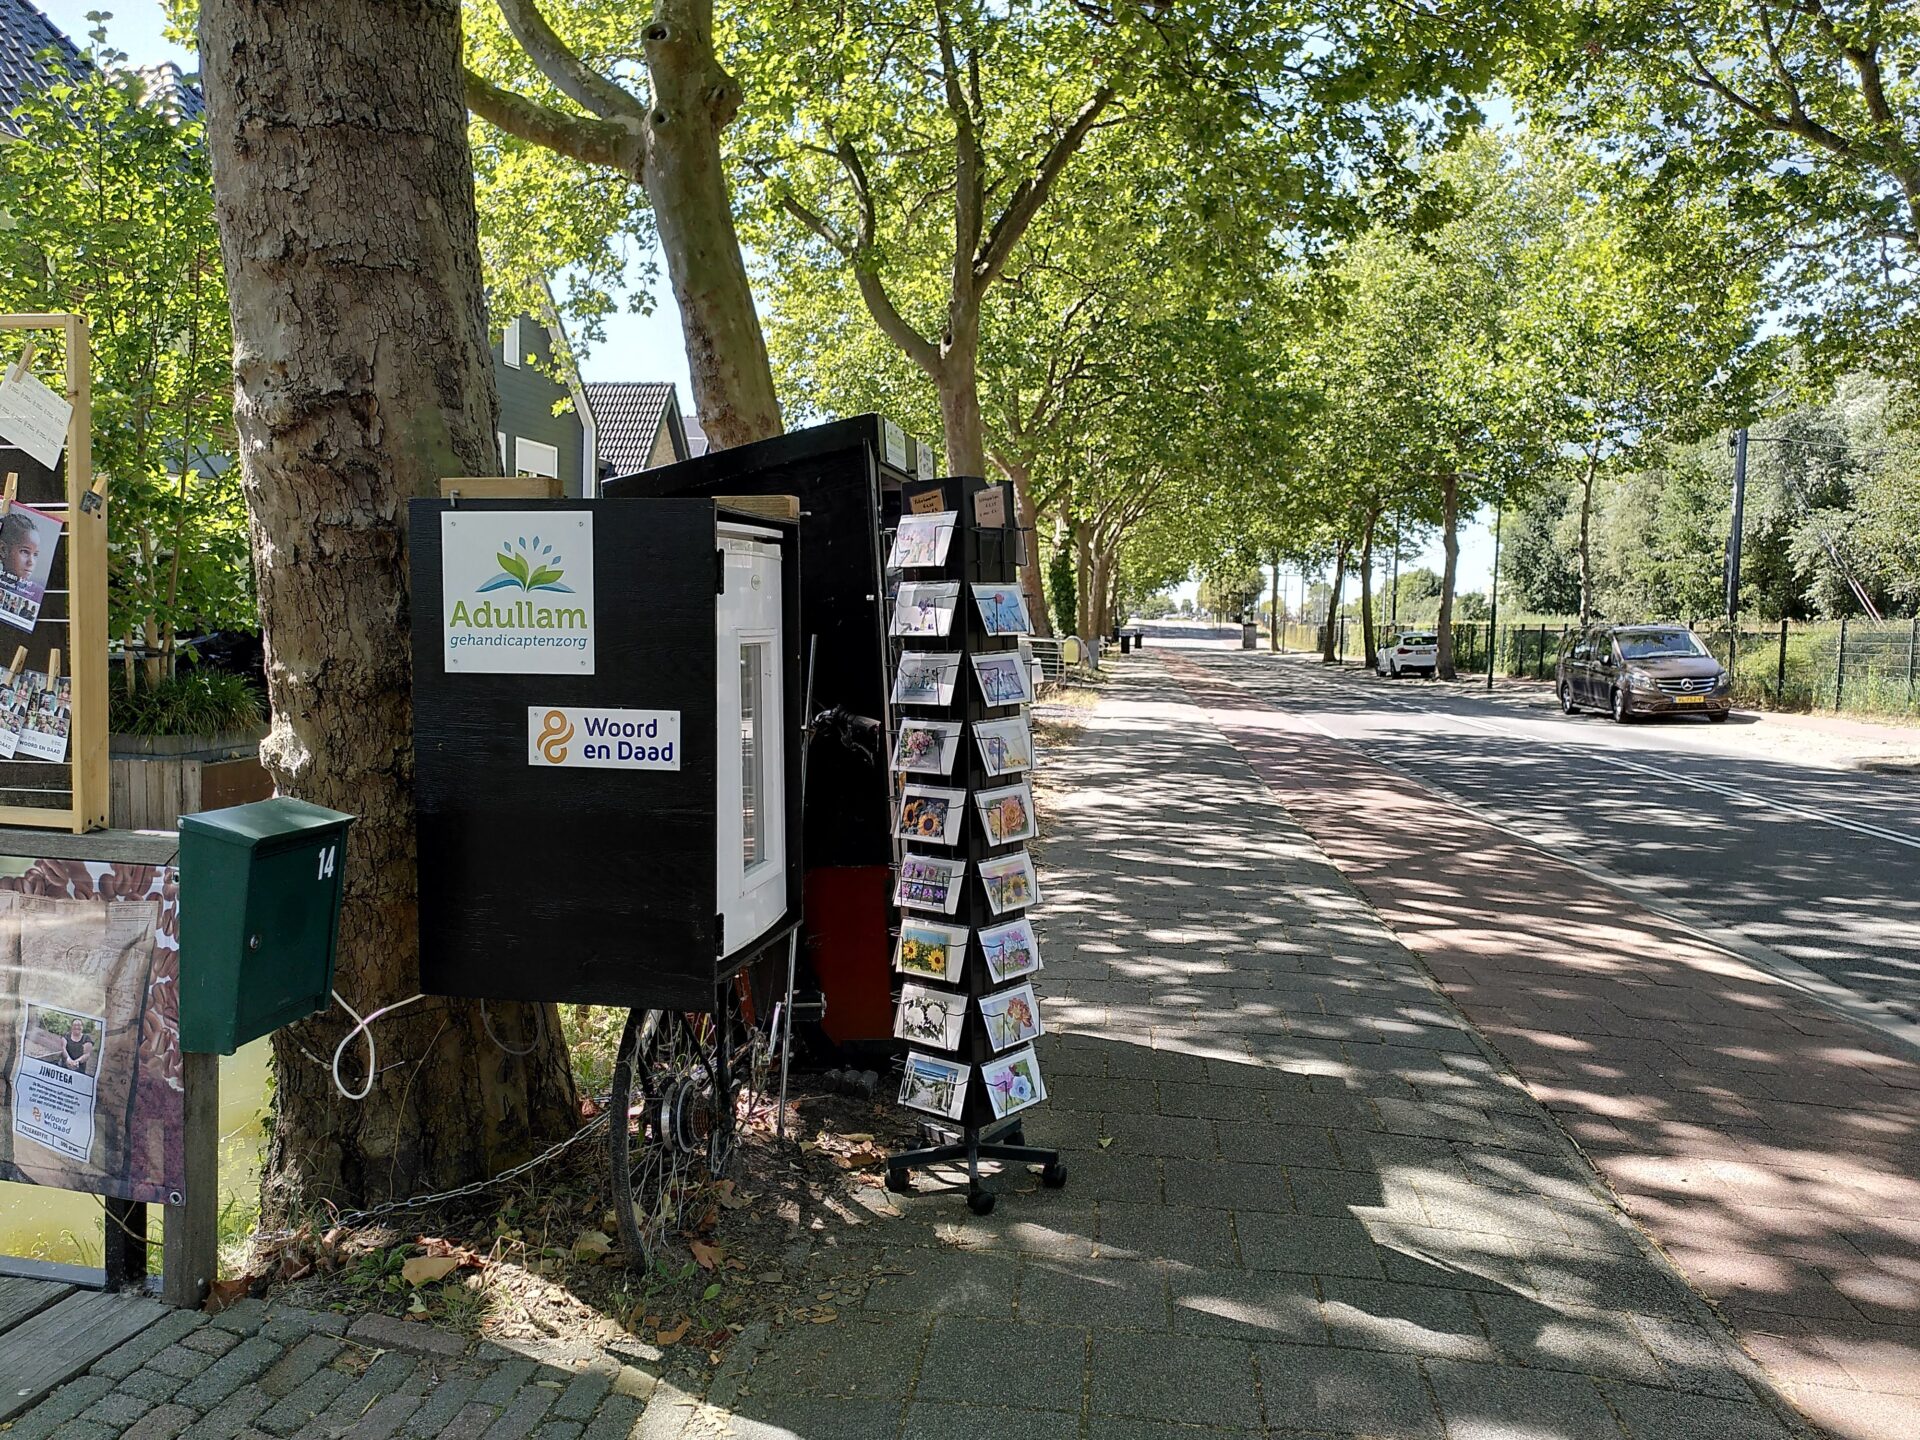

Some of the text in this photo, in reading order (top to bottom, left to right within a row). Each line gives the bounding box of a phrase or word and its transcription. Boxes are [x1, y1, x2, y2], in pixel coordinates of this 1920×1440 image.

[450, 600, 587, 629] Adullam
[450, 634, 587, 650] gehandicaptenzorg
[584, 717, 658, 738] Woord
[19, 740, 38, 749] WOORD
[47, 747, 61, 755] DAAD
[583, 741, 674, 762] en Daad
[317, 845, 336, 881] 14
[38, 1065, 73, 1086] JINOTEGA
[44, 1111, 69, 1125] Woord
[52, 1122, 72, 1135] Daad
